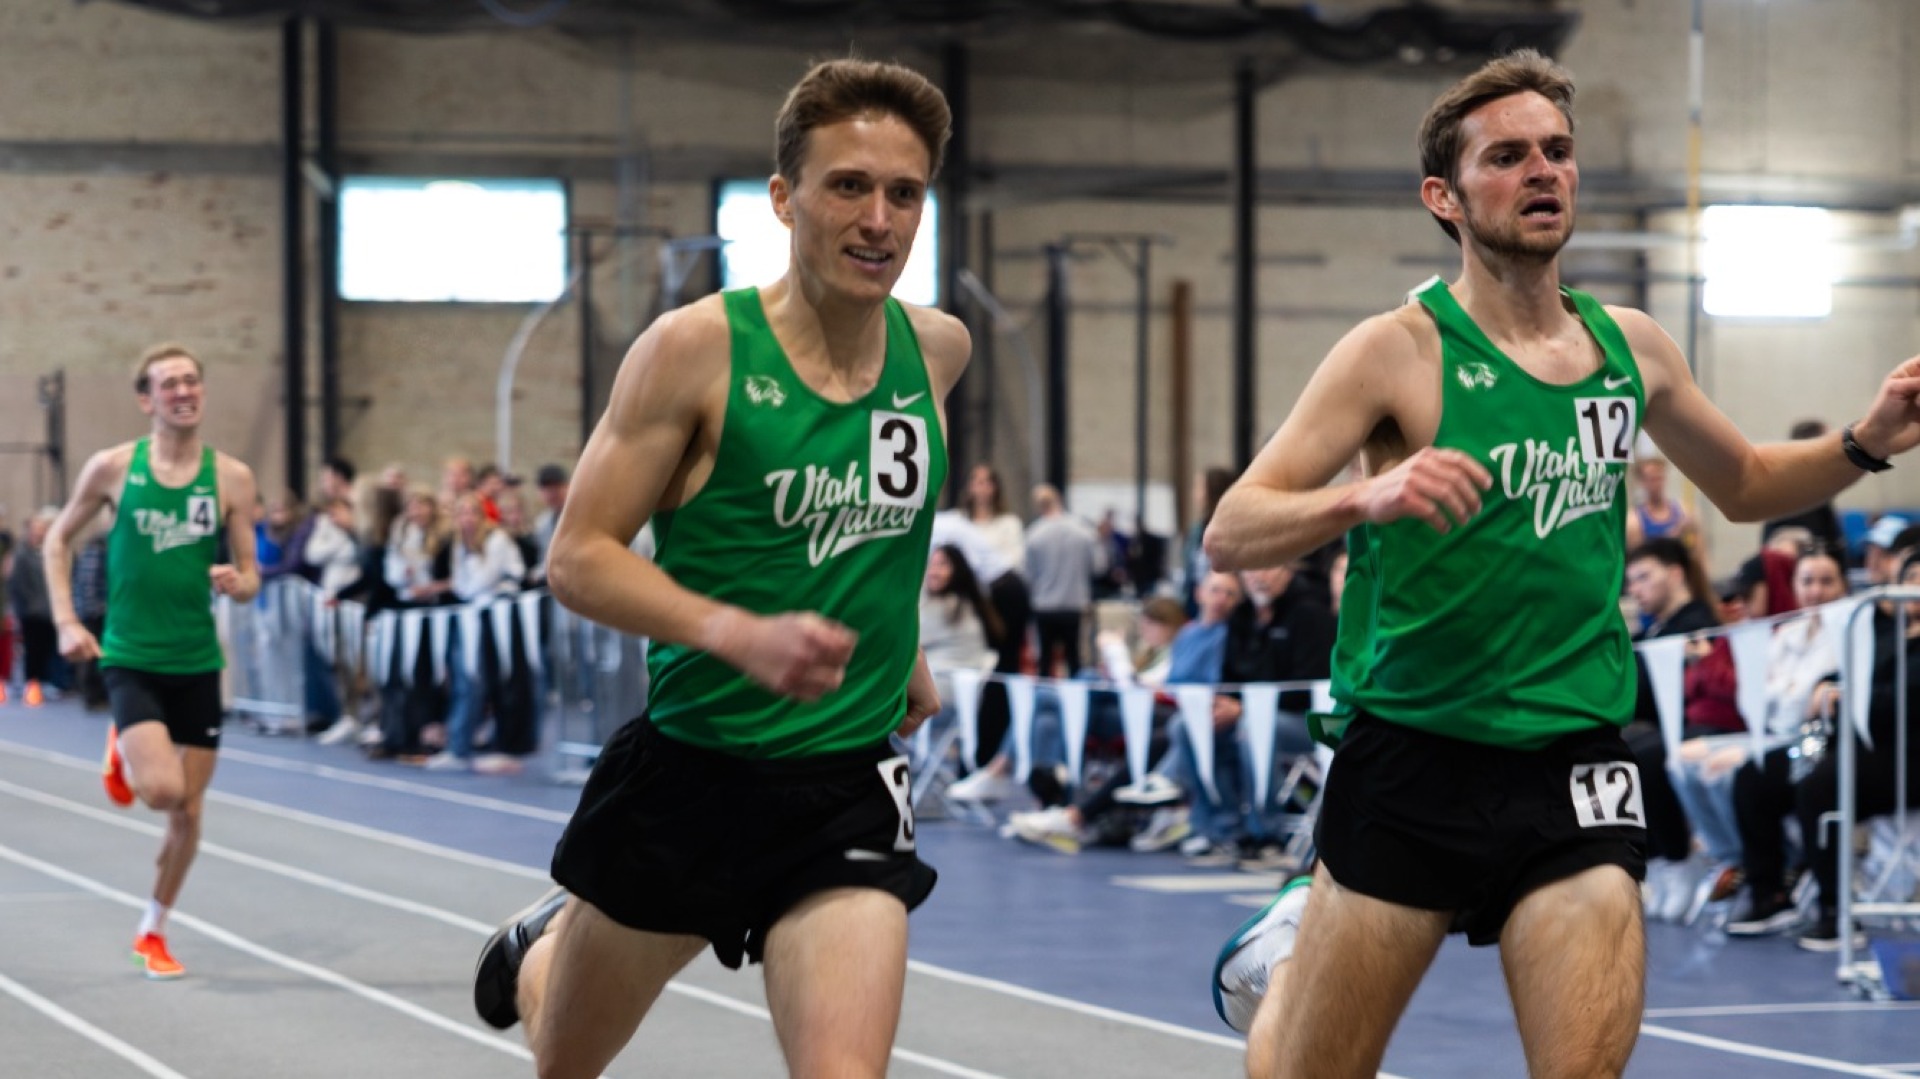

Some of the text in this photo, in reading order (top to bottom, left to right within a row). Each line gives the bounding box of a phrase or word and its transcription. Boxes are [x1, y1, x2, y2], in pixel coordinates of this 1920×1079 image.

[877, 418, 920, 500] 3
[1581, 400, 1630, 460] 12
[763, 459, 867, 529] Utah
[1489, 436, 1586, 500] Utah
[193, 500, 211, 532] 4
[1526, 461, 1625, 540] Valley
[1575, 766, 1639, 822] 12
